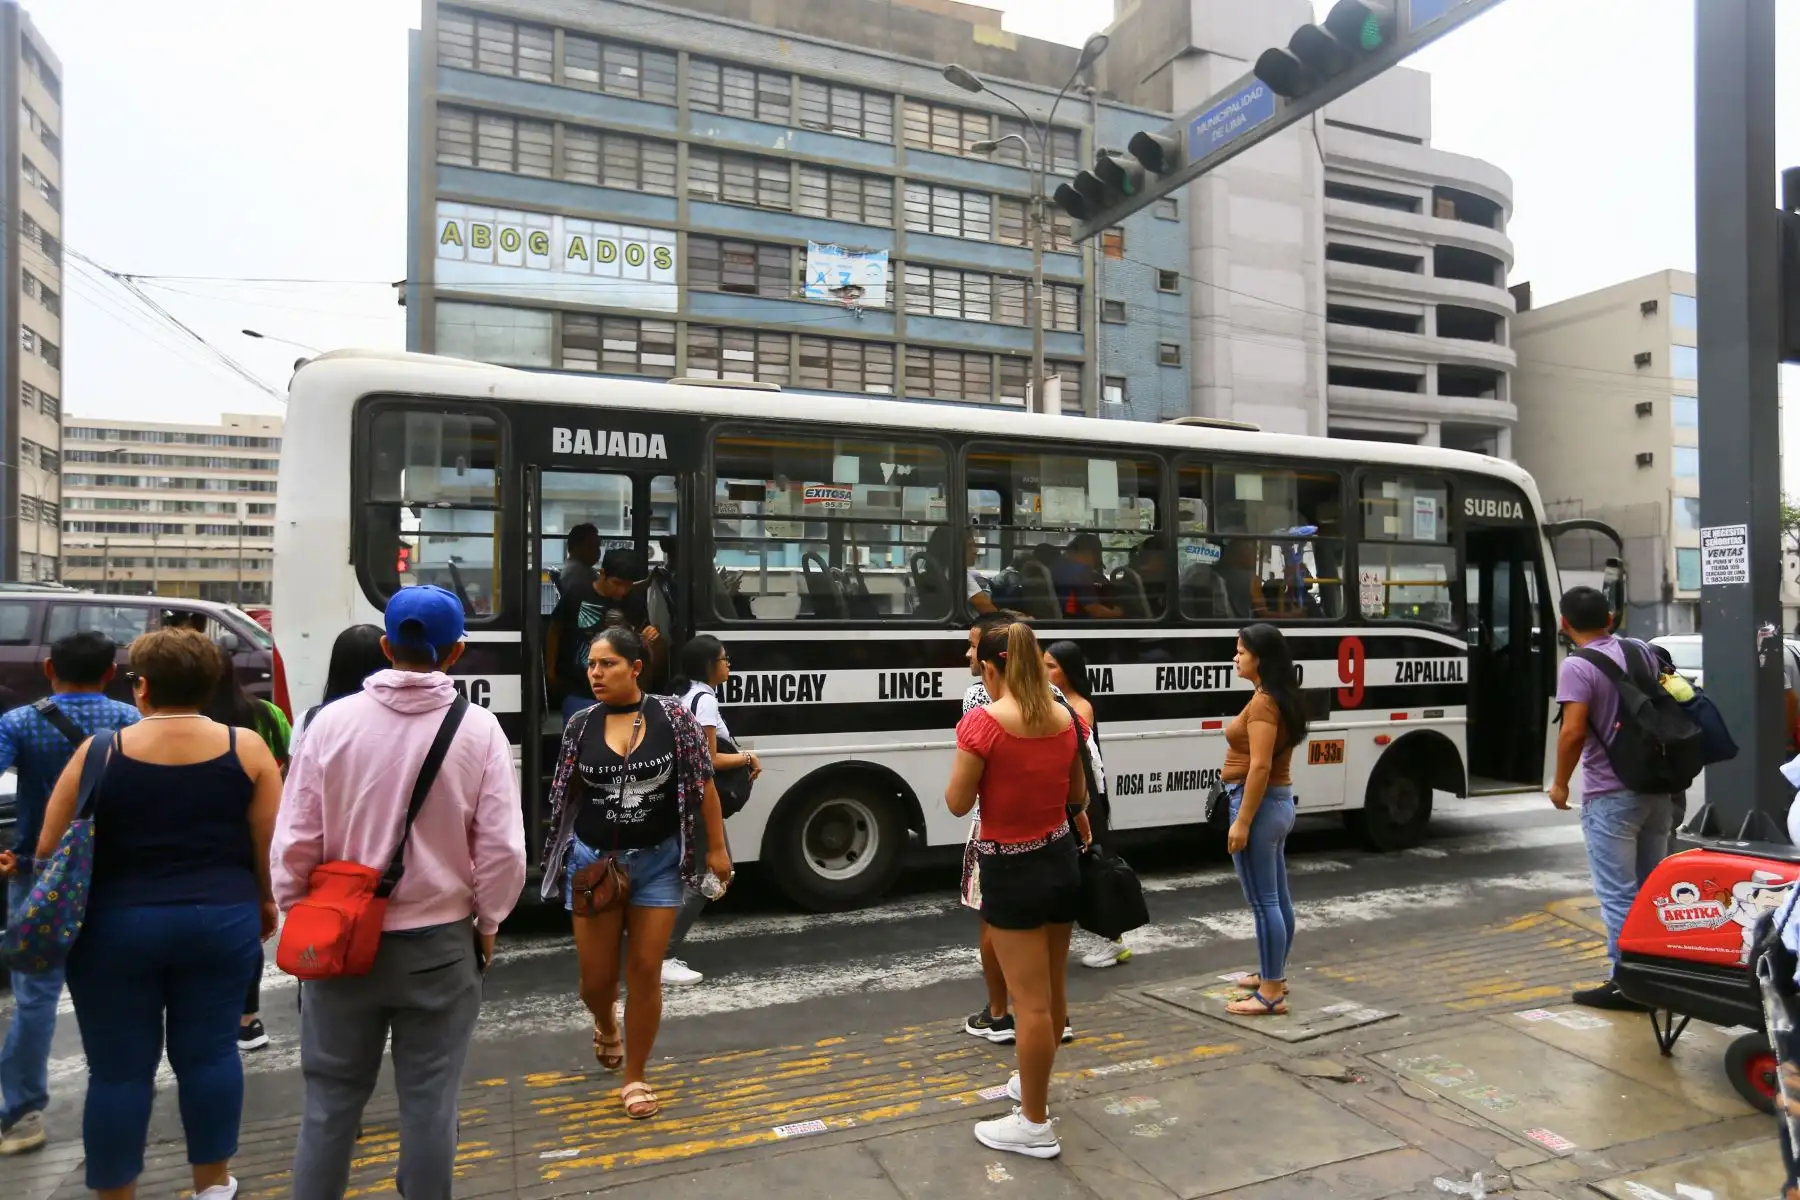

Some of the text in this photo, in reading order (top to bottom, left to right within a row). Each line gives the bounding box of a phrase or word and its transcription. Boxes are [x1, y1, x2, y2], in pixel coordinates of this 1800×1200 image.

[1196, 86, 1264, 136] MUNICIPALIDAD
[1211, 113, 1247, 142] DE LIMA
[552, 427, 668, 460] BAJADA
[805, 488, 852, 500] EXITOSA
[1464, 498, 1524, 519] SUBIDA
[1708, 547, 1744, 558] VENTAS
[879, 671, 943, 700] LINCE
[1156, 665, 1234, 691] FAUCETT
[1395, 661, 1463, 683] ZAPALLAL
[1337, 635, 1365, 709] 9
[599, 765, 623, 774] STOP
[628, 752, 674, 771] EXPLORING
[1116, 768, 1222, 796] ROSA DE LAS AMERICAS
[1664, 906, 1722, 921] ARTIKA
